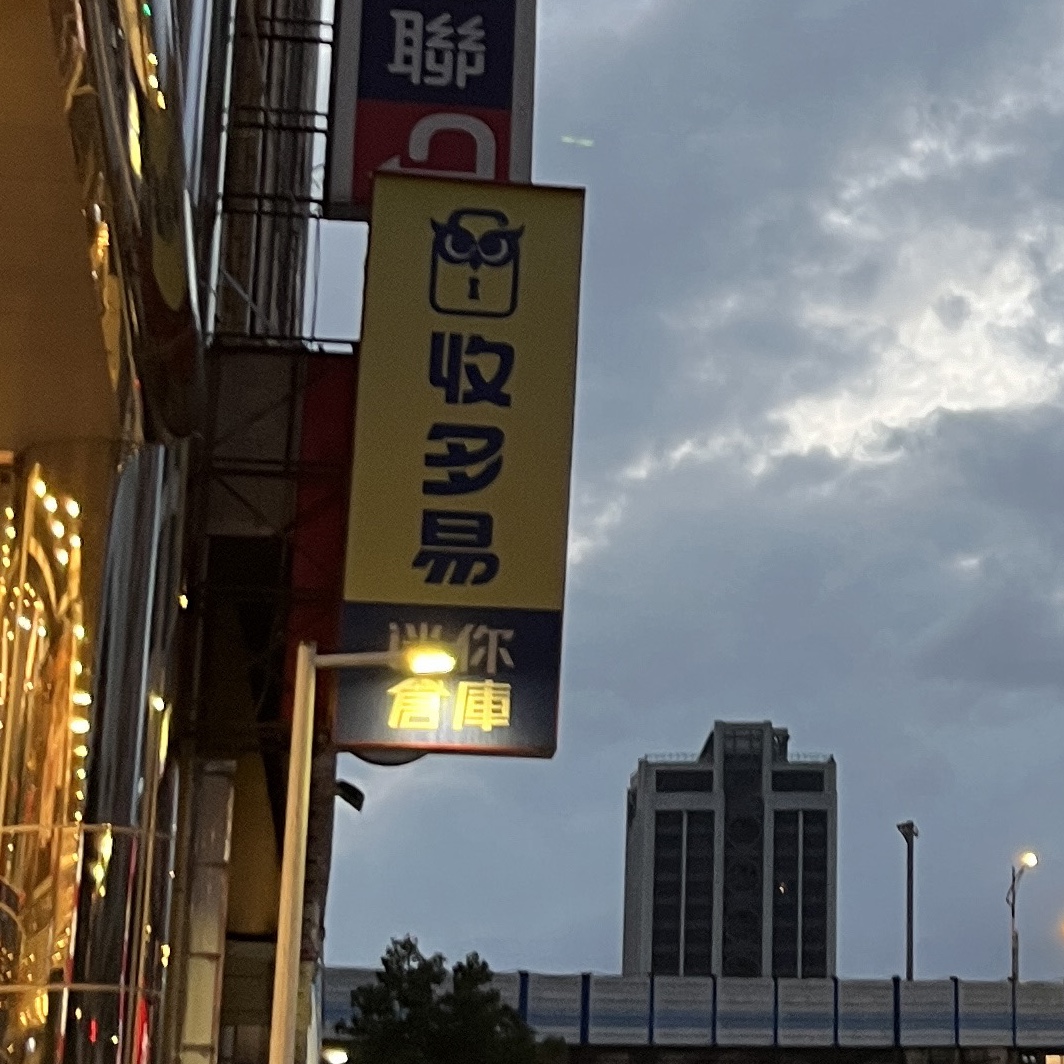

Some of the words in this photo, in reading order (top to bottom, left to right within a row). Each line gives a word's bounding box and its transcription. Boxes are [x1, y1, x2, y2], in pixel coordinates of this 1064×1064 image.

[411, 330, 517, 587] 收多易
[386, 677, 513, 732] 倉庫
